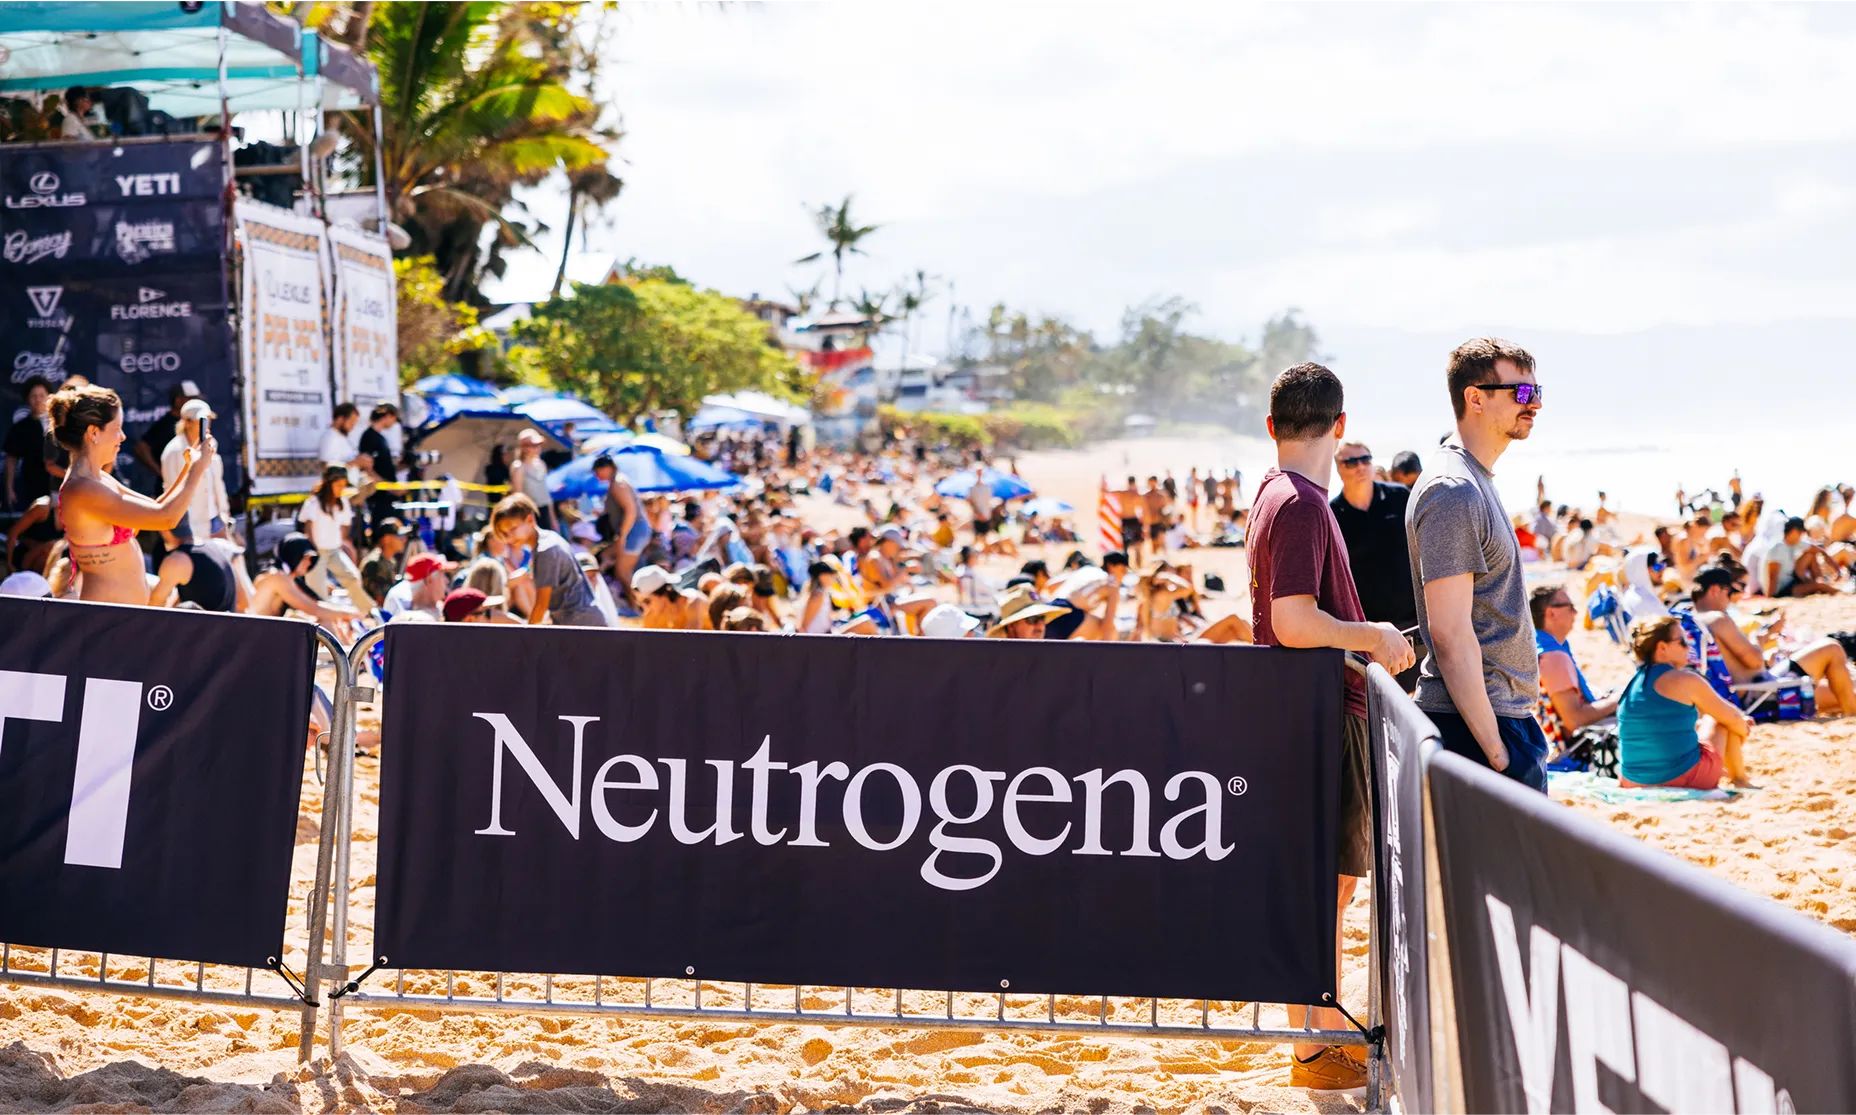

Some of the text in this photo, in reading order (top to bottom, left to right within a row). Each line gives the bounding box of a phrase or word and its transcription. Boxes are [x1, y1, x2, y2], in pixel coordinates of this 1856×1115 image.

[115, 172, 181, 197] YETI
[5, 192, 87, 208] LEXUS
[111, 301, 191, 320] FLORENCE
[120, 352, 181, 373] eero
